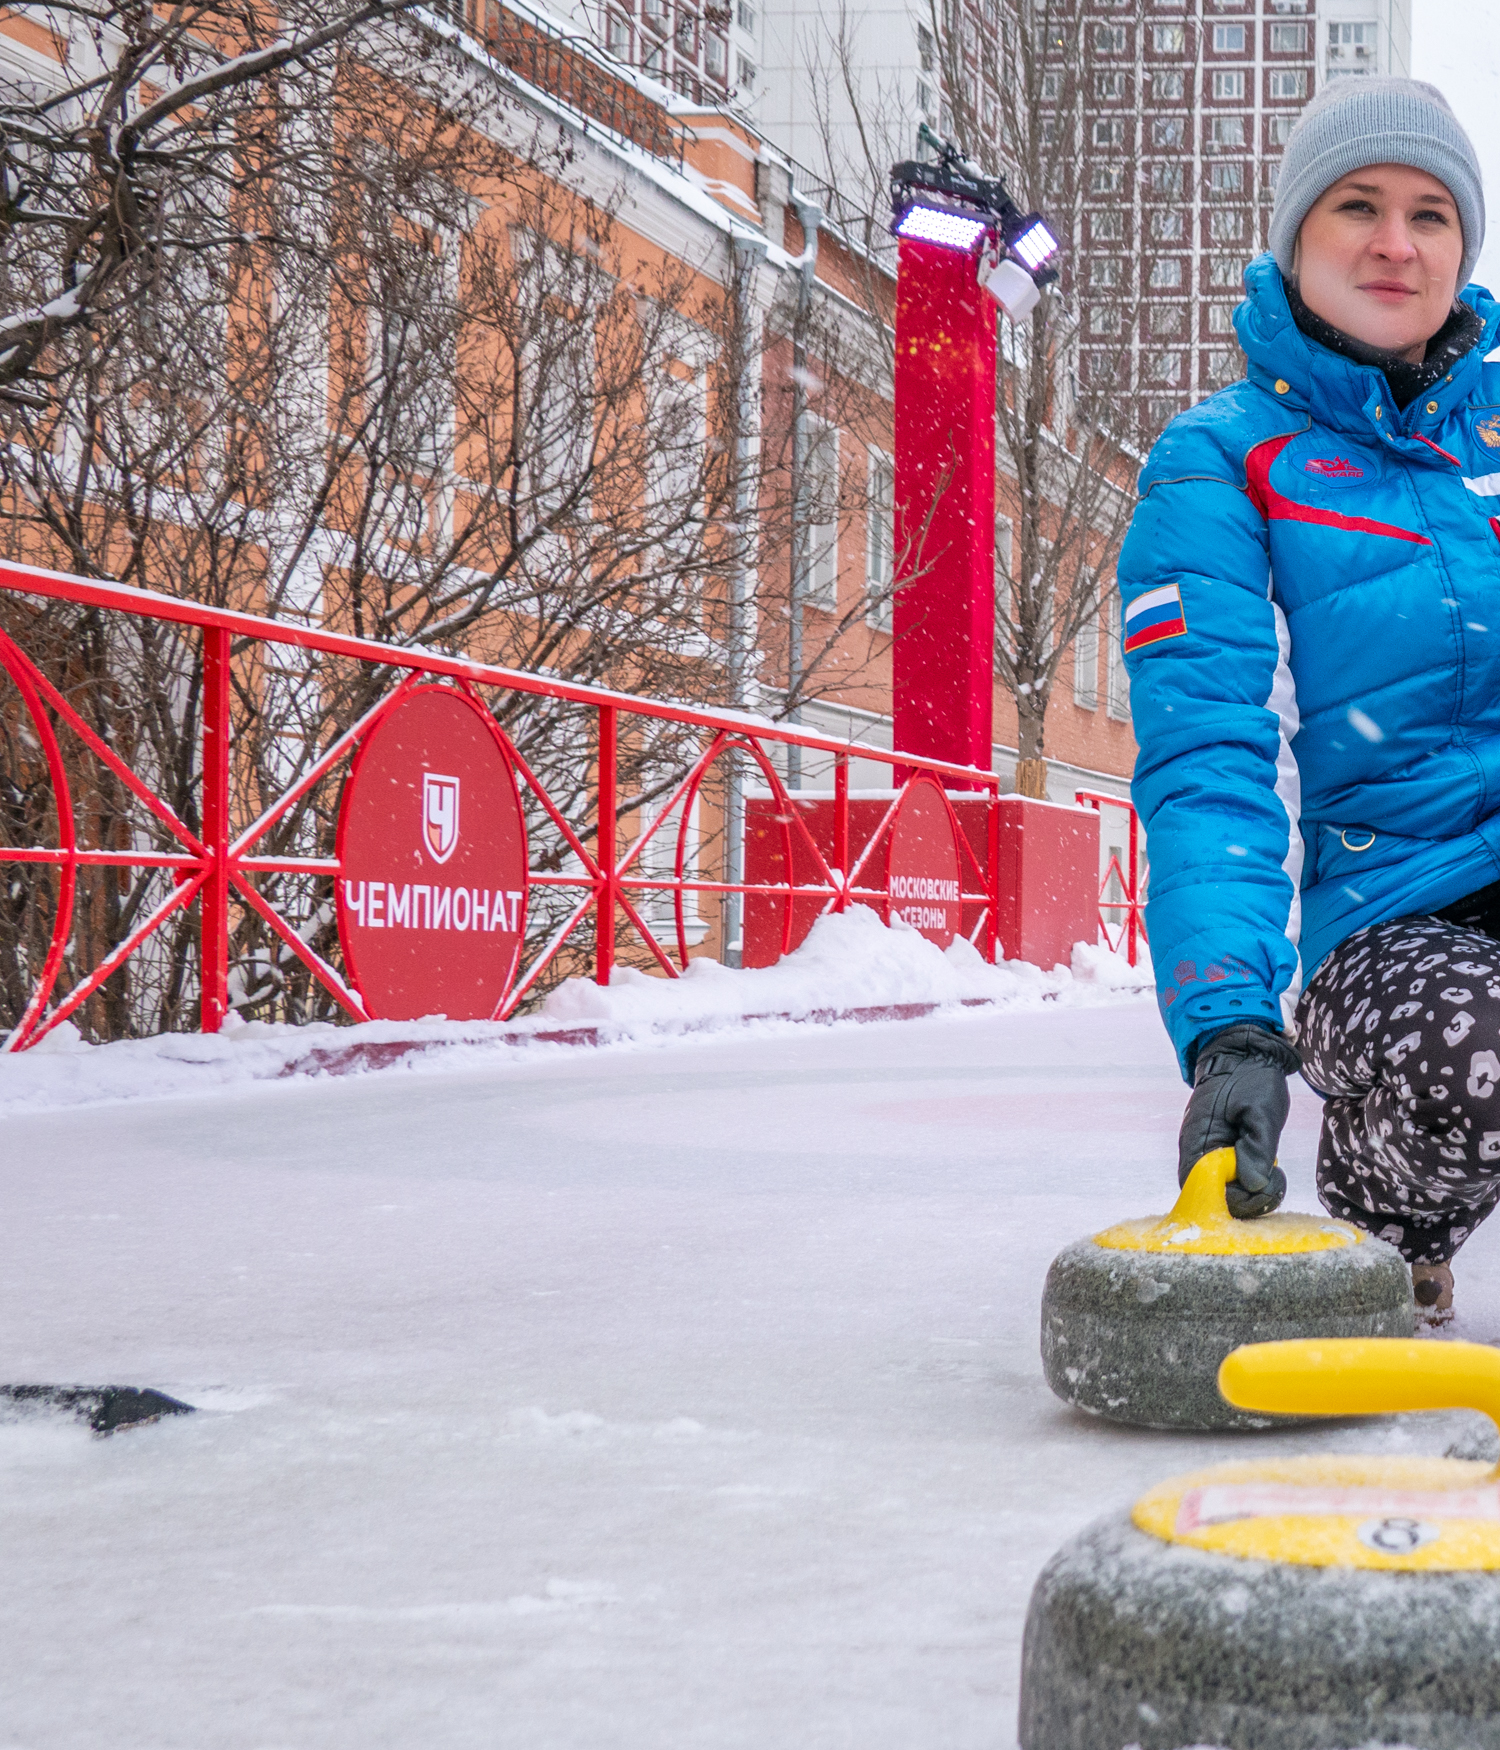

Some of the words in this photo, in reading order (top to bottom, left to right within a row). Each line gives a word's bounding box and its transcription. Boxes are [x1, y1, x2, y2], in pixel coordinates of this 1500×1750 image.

[1304, 464, 1364, 478] FORWARD
[890, 875, 959, 901] МОСКОВСКИЕ
[345, 880, 522, 932] ЧЕМПИОНАТ
[903, 906, 946, 929] СЕЗОНЫ
